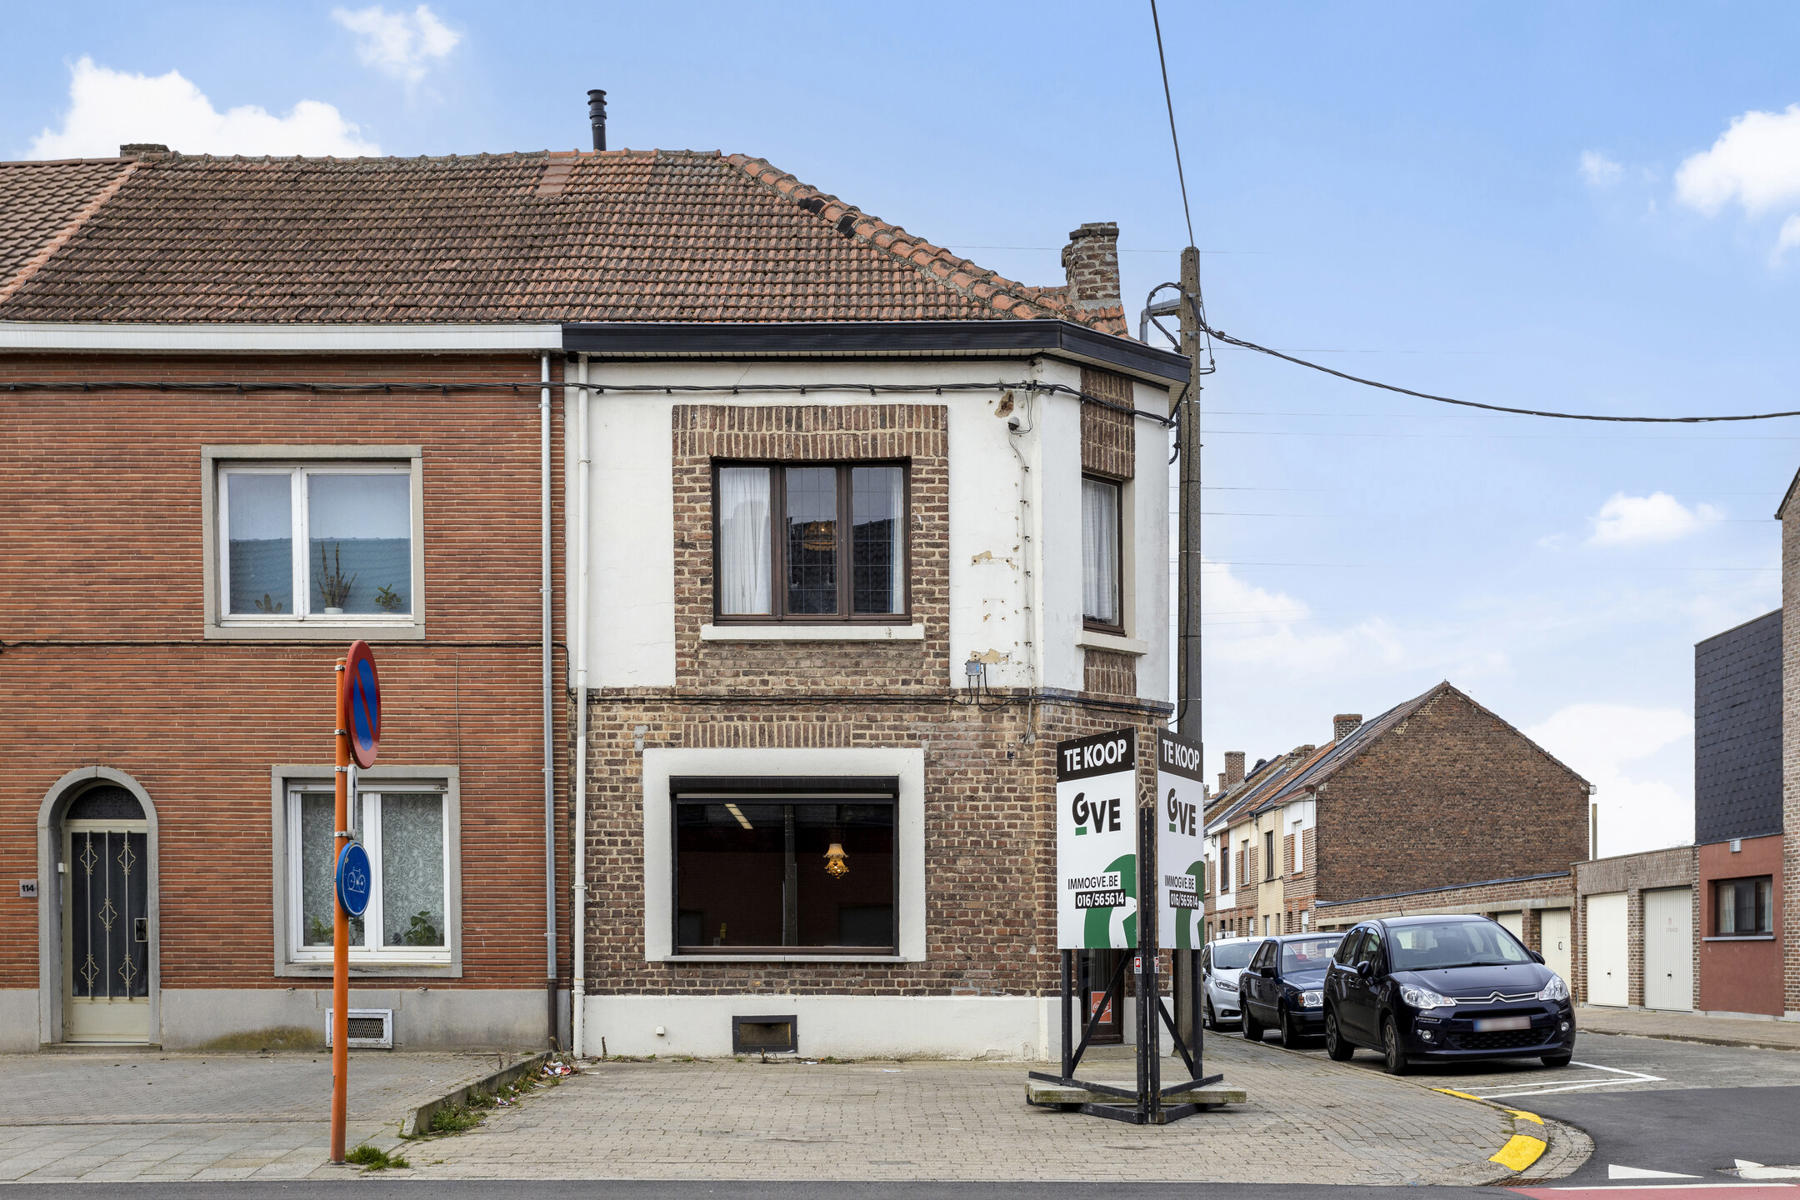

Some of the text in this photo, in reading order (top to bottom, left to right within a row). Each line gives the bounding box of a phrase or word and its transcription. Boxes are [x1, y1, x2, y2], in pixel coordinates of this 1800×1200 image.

[1064, 739, 1127, 772] TE KOOP
[1162, 739, 1200, 771] TE KOOP
[1072, 792, 1121, 834] GVE
[1167, 787, 1197, 837] GVE
[22, 884, 35, 892] 114
[1067, 875, 1119, 890] IMMOGVE.BE
[1077, 892, 1125, 907] 016/565614
